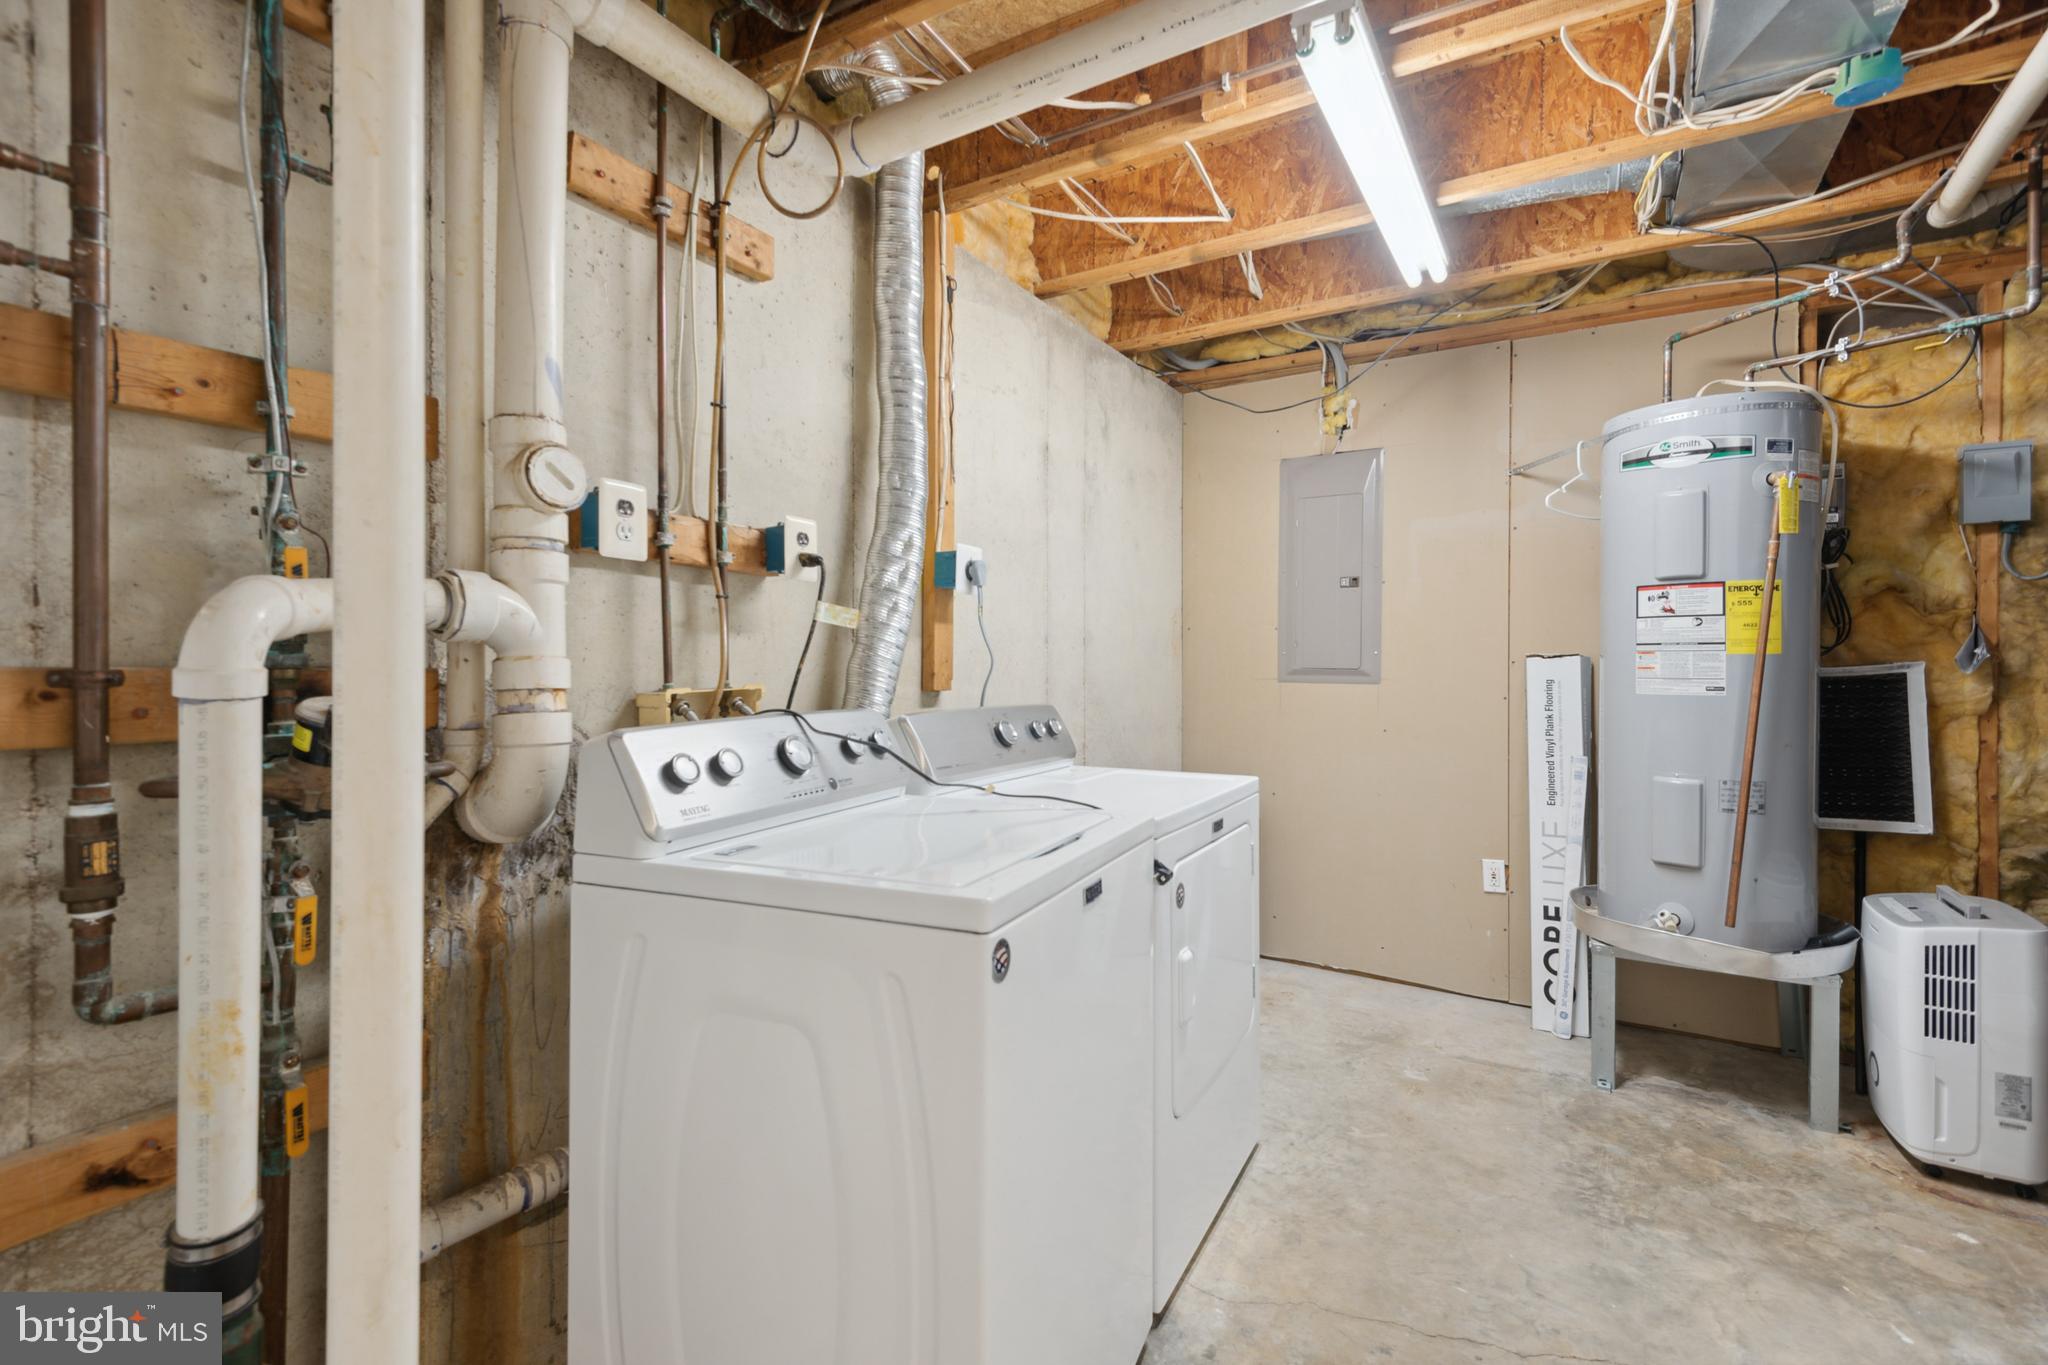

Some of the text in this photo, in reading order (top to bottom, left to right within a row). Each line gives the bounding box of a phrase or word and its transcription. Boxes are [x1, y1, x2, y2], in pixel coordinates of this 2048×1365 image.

[1673, 439, 1701, 449] Smith
[1544, 679, 1558, 806] Engineered Vinyl Plank Flooring
